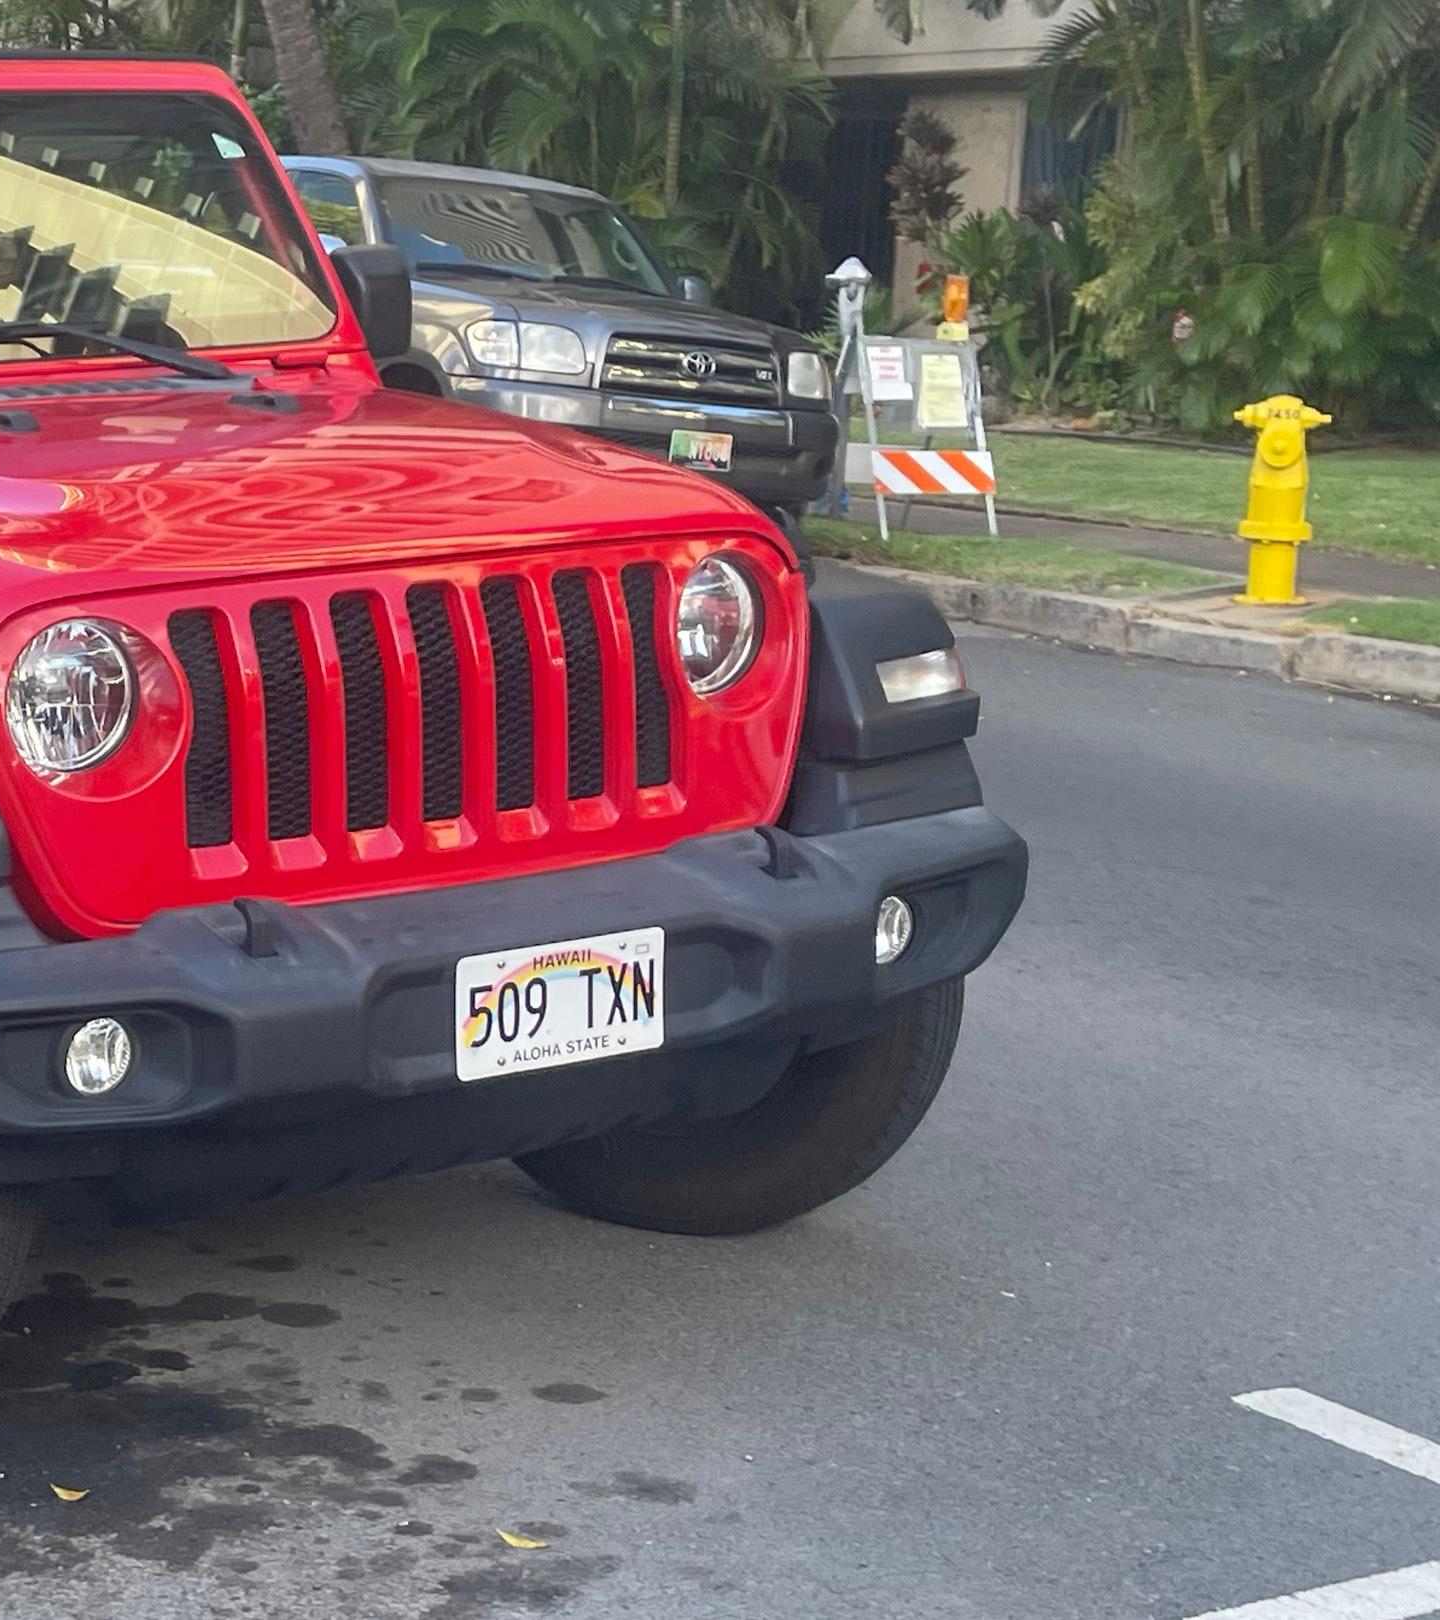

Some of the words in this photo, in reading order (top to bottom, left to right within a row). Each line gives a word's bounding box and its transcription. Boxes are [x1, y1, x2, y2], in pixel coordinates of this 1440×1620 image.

[532, 949, 592, 971] HAWAII
[469, 976, 548, 1048] 509
[578, 958, 656, 1029] TXN
[513, 1043, 561, 1063] ALOHA
[565, 1034, 610, 1054] STATE
